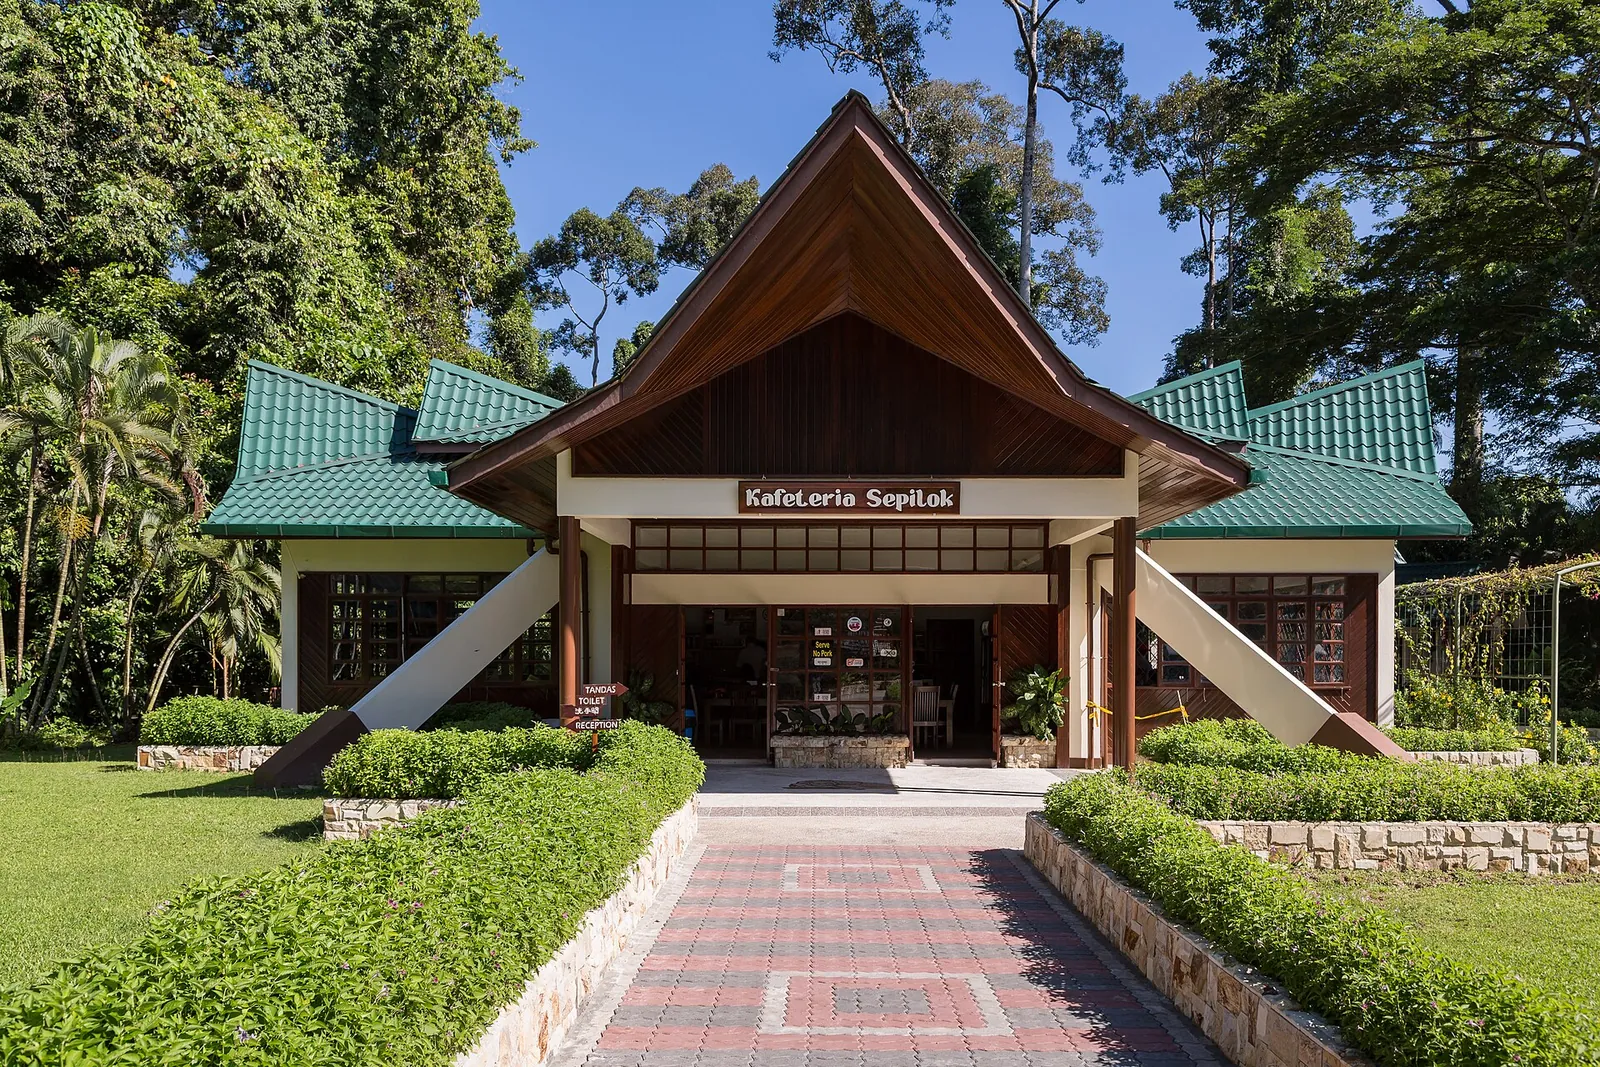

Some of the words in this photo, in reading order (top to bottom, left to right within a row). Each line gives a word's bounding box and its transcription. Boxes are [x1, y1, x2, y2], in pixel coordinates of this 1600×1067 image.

[745, 488, 856, 507] Kafeteria
[866, 488, 954, 511] Sepilok
[815, 641, 830, 649] Serve
